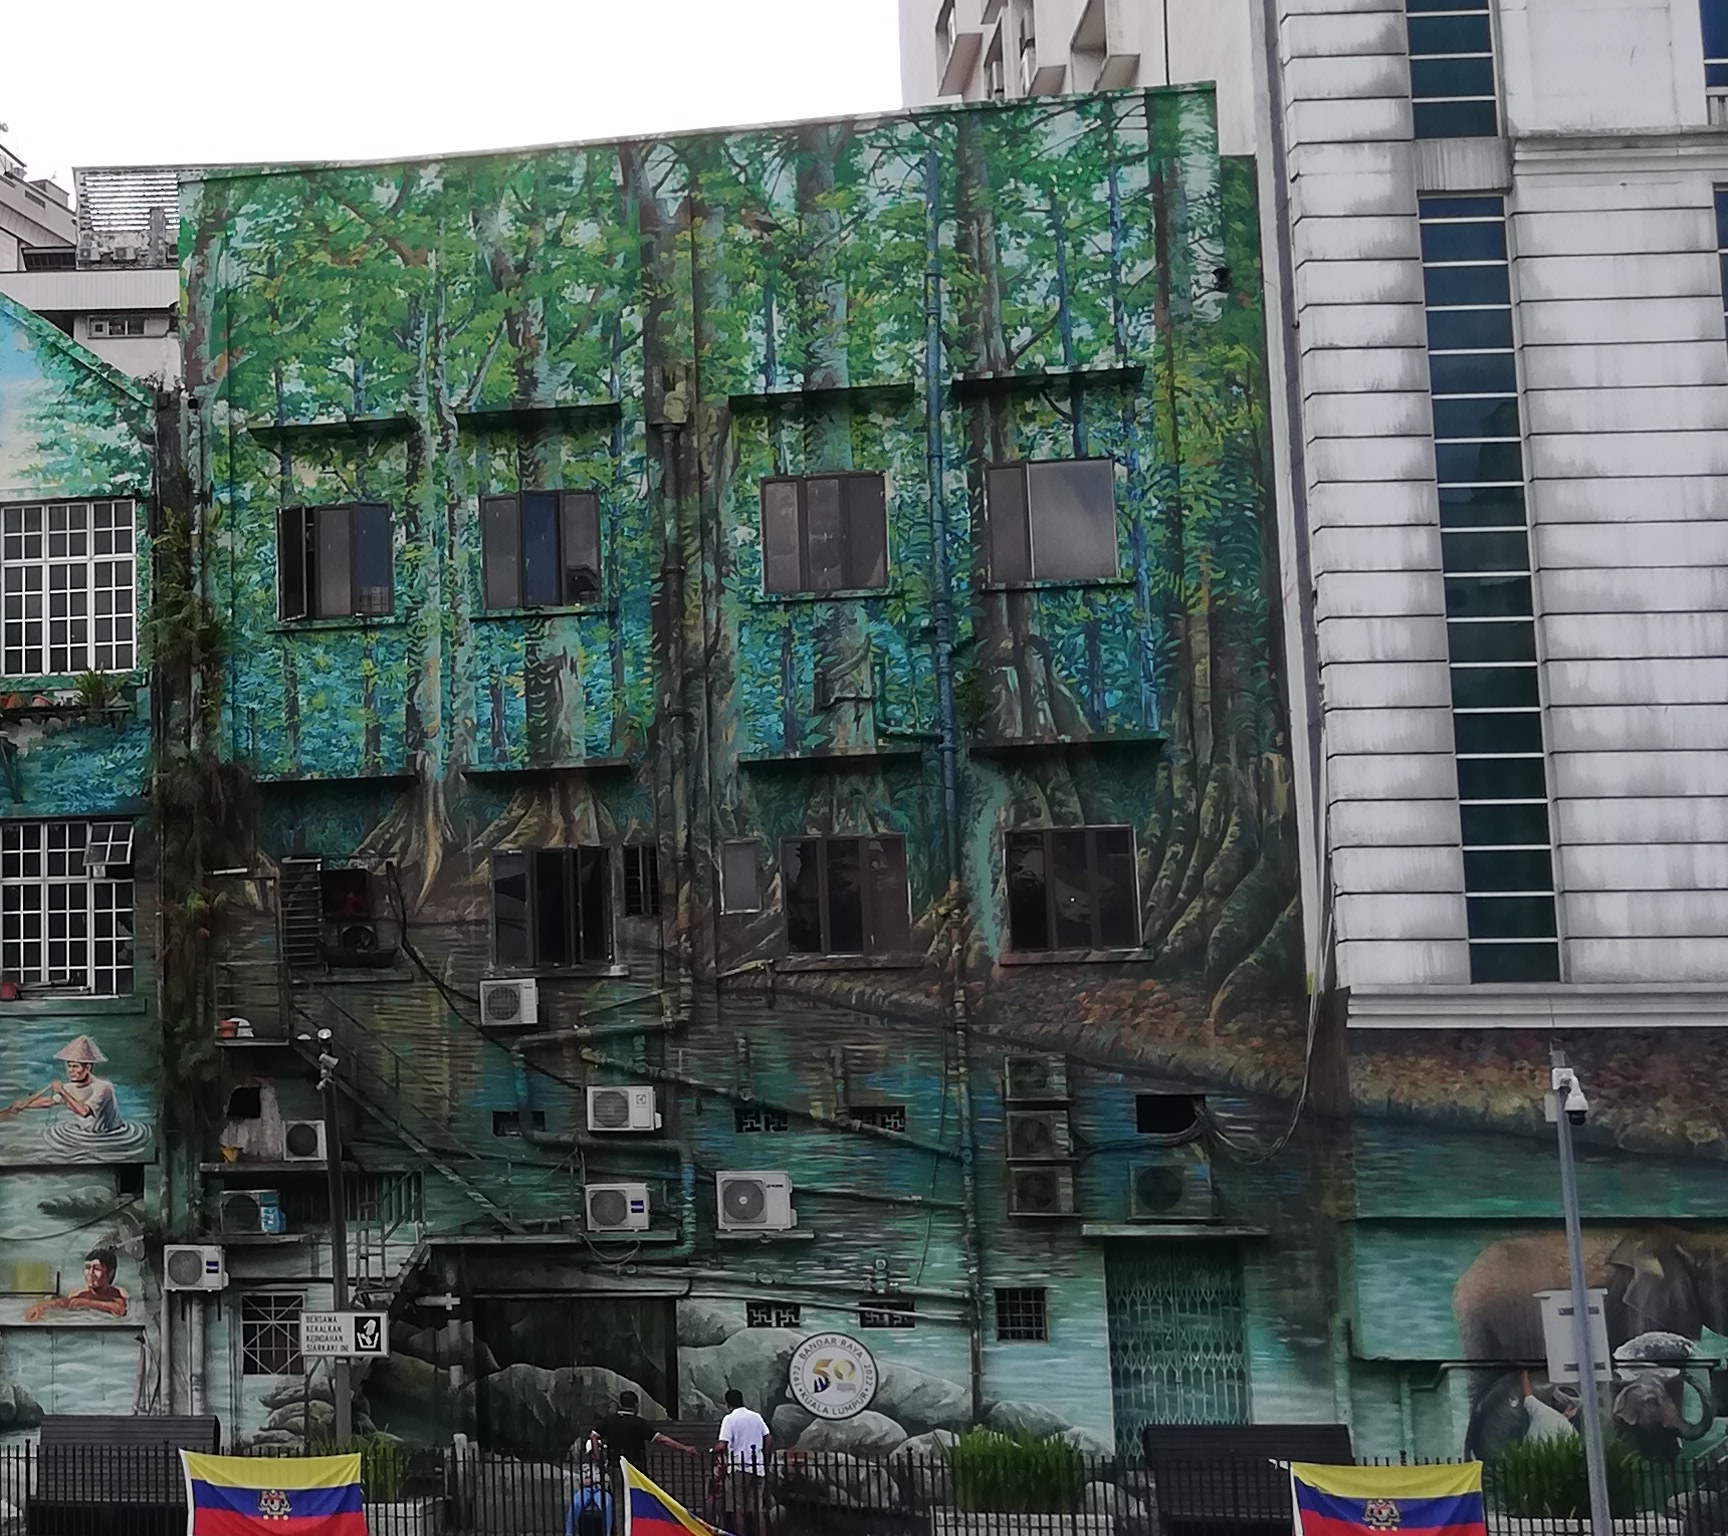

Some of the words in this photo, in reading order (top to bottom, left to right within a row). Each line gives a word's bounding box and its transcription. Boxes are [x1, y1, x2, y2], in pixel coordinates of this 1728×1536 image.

[305, 1315, 338, 1324] BERSAMA
[305, 1325, 342, 1333] KEKALKAN
[798, 1337, 837, 1360] BANDAR
[840, 1339, 863, 1359] RAYA
[792, 1365, 801, 1387] 1972
[864, 1363, 874, 1387] 2022
[800, 1391, 830, 1415] KUALA
[832, 1392, 869, 1416] LUMPUR
